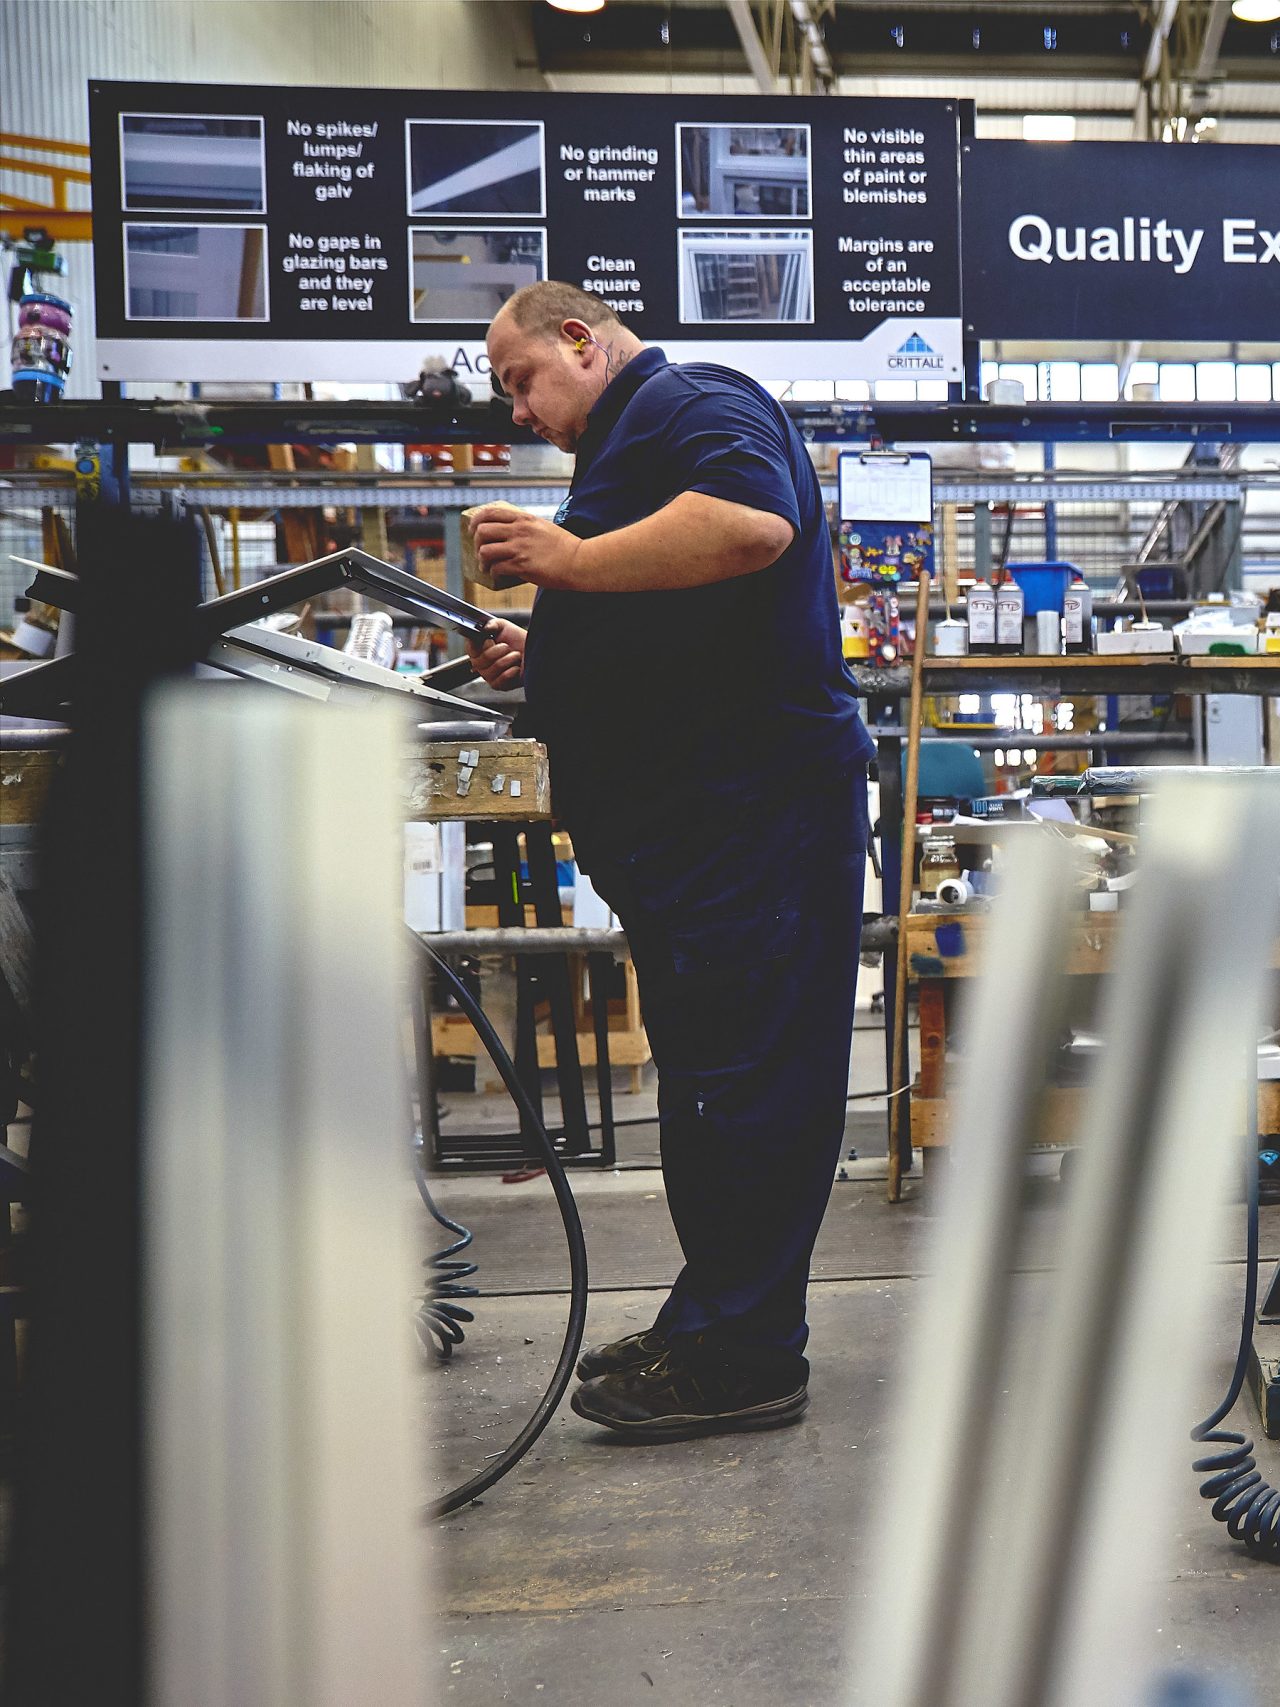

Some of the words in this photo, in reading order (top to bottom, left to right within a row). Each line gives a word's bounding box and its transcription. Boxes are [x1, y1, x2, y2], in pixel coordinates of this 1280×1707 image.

[288, 120, 311, 135] No
[316, 120, 378, 139] spikes/
[844, 128, 867, 143] No
[871, 128, 924, 144] visible
[303, 142, 362, 160] lumps/
[561, 145, 584, 160] No
[588, 146, 658, 164] grinding
[844, 148, 875, 163] thin
[880, 152, 924, 163] areas
[292, 162, 352, 181] flaking
[356, 163, 375, 178] of
[564, 169, 583, 180] or
[587, 166, 655, 181] hammer
[843, 168, 860, 183] of
[864, 168, 905, 186] paint
[909, 172, 927, 183] or
[316, 183, 352, 201] galv
[584, 186, 636, 202] marks
[844, 188, 926, 203] blemishes
[289, 234, 313, 248] No
[318, 237, 360, 252] gaps
[365, 234, 381, 249] in
[839, 237, 903, 255] Margins
[908, 241, 933, 252] are
[1008, 215, 1204, 274] Quality
[283, 254, 345, 272] glazing
[350, 255, 388, 270] bars
[587, 256, 635, 271] Clean
[866, 257, 883, 272] of
[887, 261, 906, 272] an
[299, 275, 331, 289] and
[336, 275, 373, 293] they
[582, 279, 641, 294] square
[843, 278, 930, 295] acceptable
[301, 298, 328, 310] are
[333, 296, 372, 310] level
[849, 298, 925, 311] tolerance
[888, 357, 944, 369] CRITTALL
